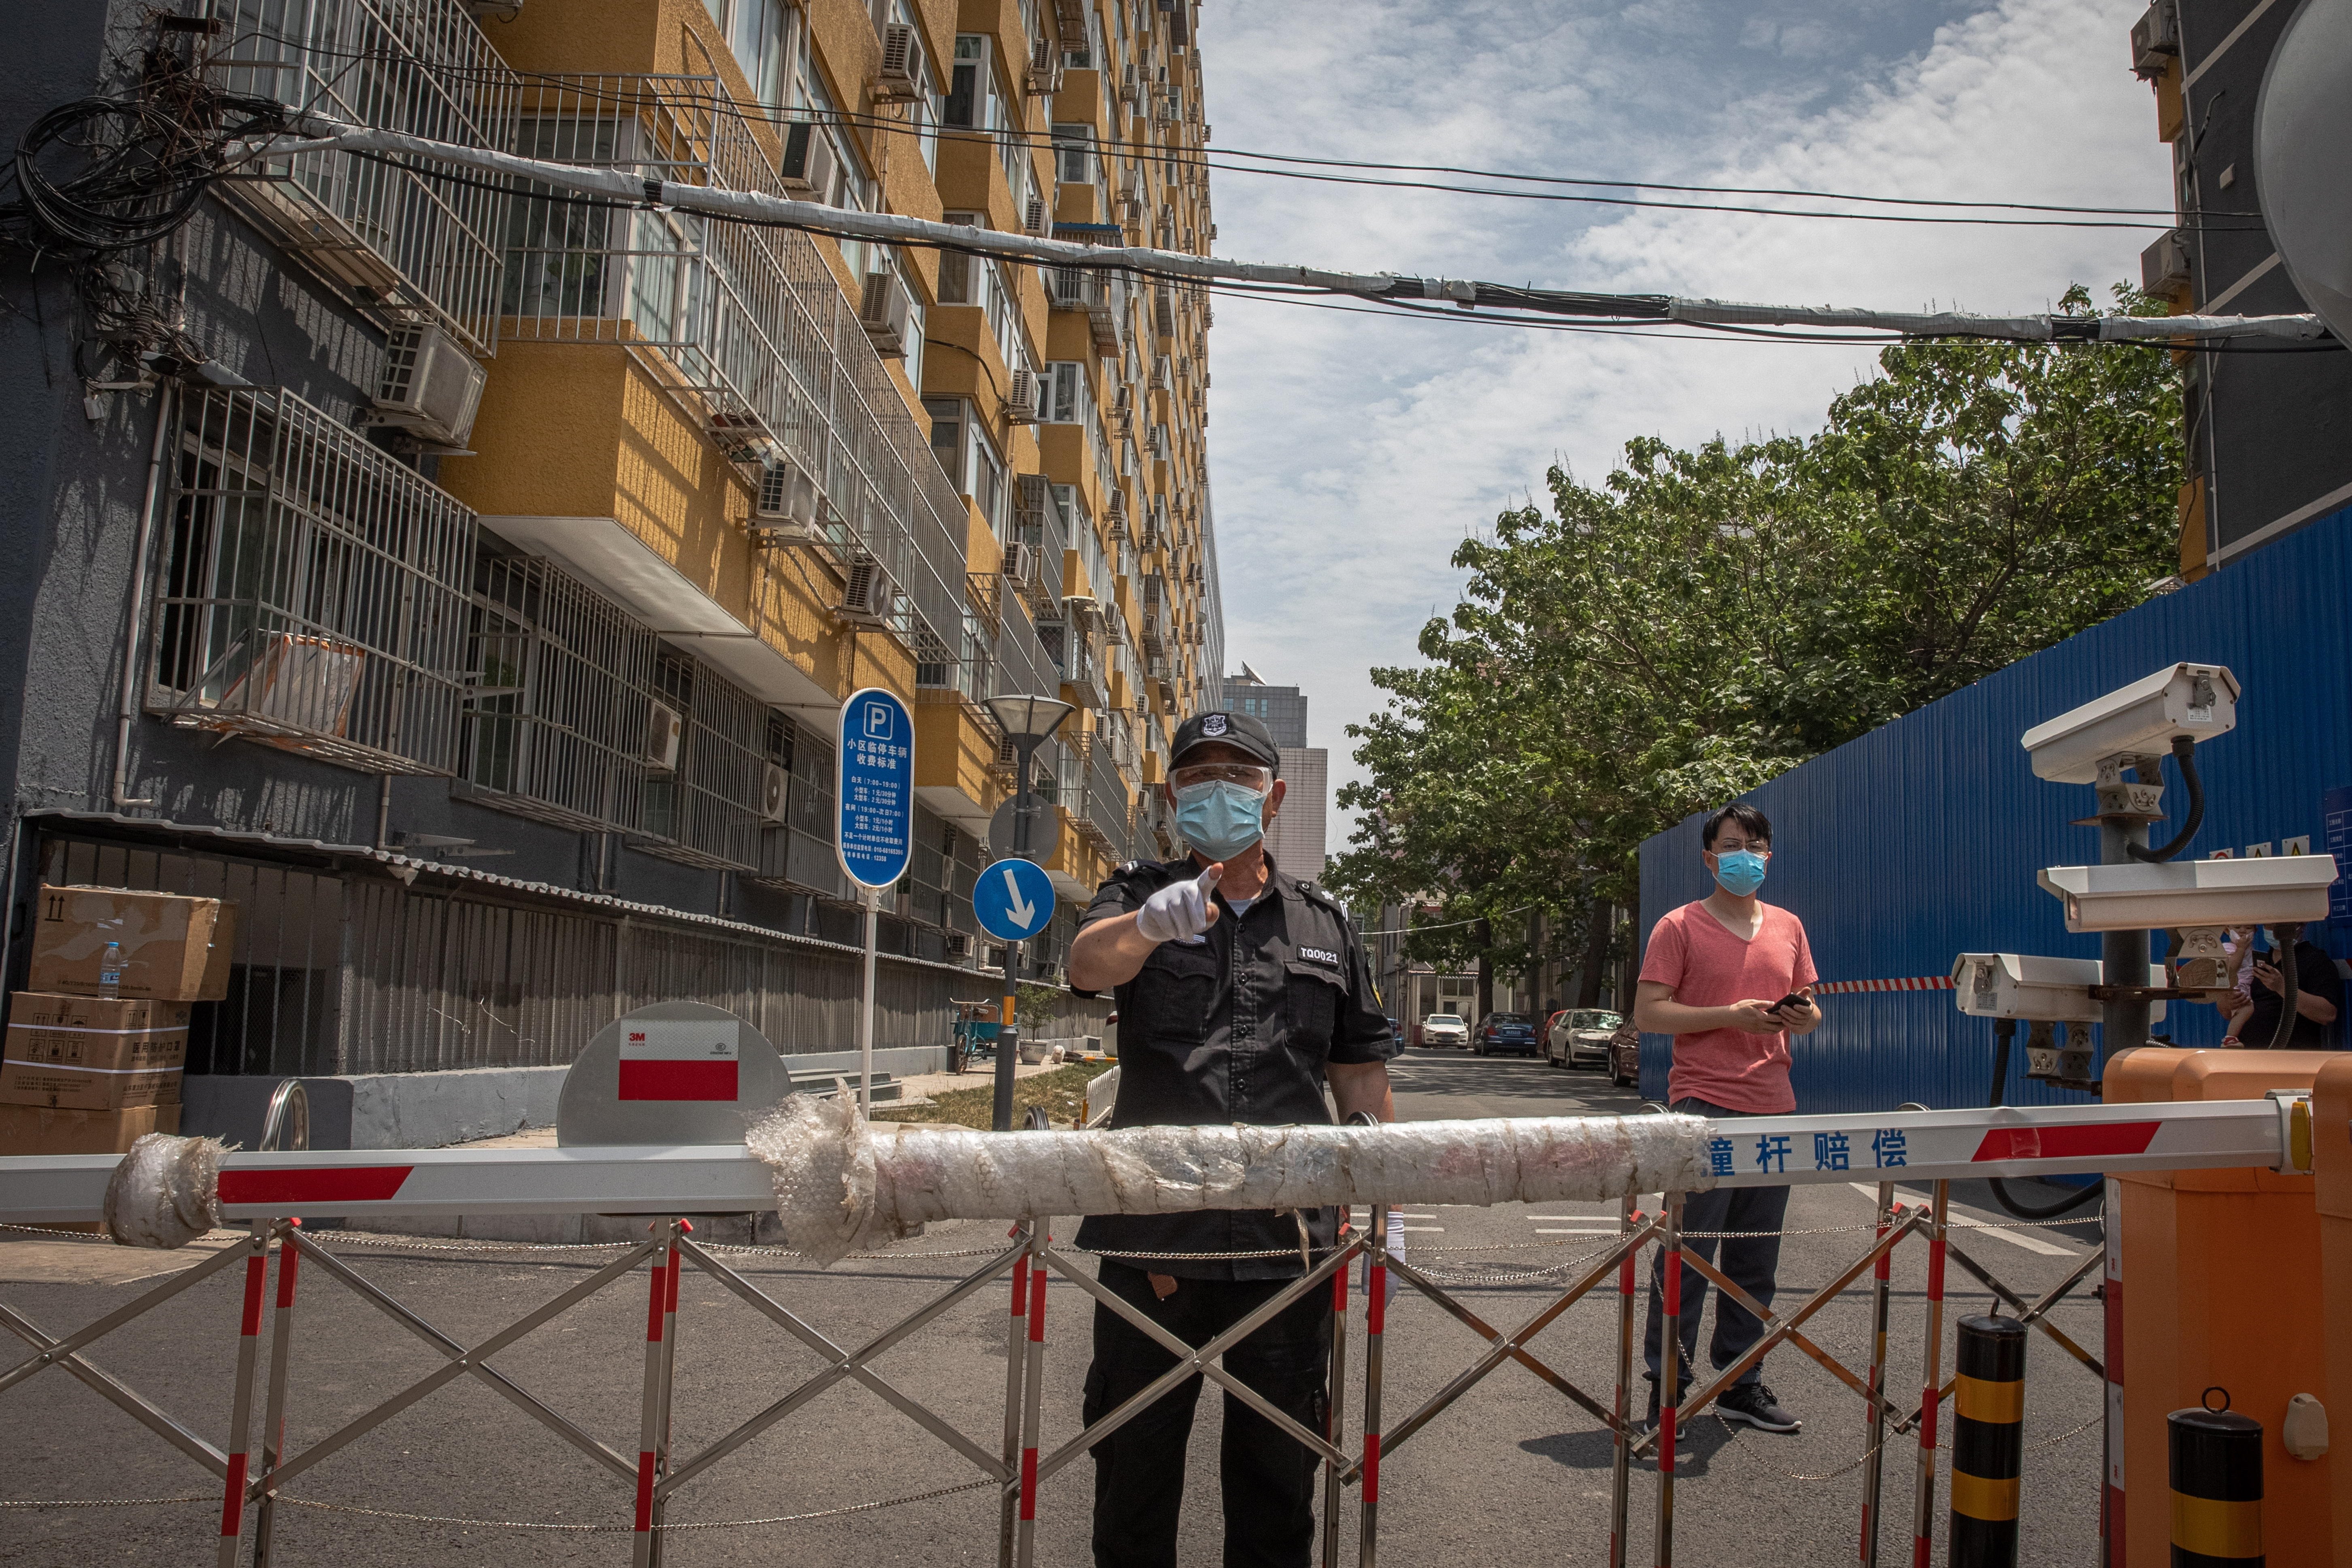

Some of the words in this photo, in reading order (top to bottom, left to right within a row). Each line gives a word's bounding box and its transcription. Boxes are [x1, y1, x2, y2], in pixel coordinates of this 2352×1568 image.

[870, 707, 886, 732] P
[847, 738, 907, 758] 小区临停车辆
[857, 753, 897, 770] 收费标准
[844, 832, 903, 845] 不足一个计时单位不收取费用
[629, 1033, 645, 1041] 3M
[133, 1040, 181, 1053] 医用防护口罩
